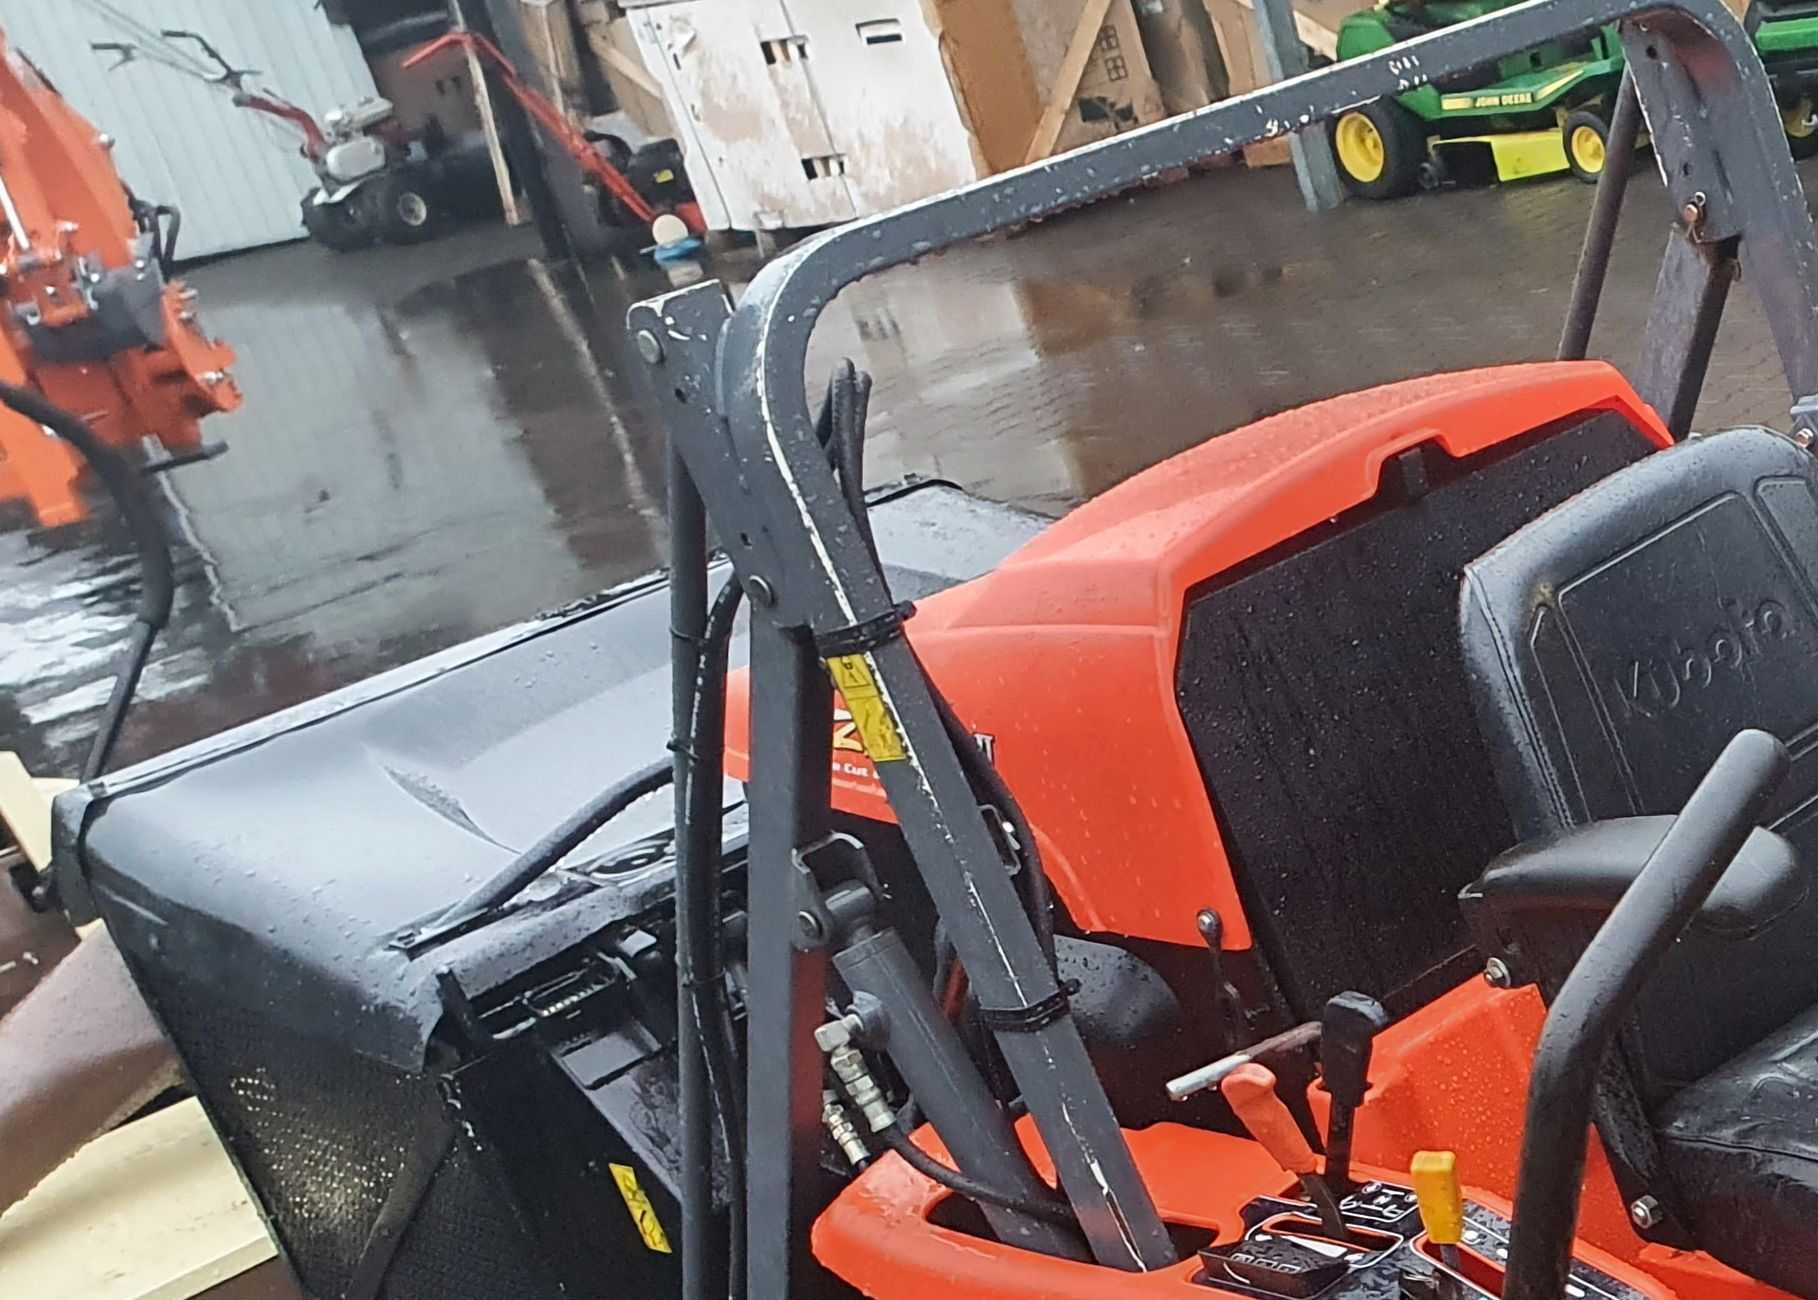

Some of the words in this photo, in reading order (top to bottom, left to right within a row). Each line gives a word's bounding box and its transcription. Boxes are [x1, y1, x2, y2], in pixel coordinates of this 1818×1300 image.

[1474, 96, 1500, 107] JOHN
[1501, 92, 1532, 105] DEERE
[1612, 598, 1797, 718] Kubota
